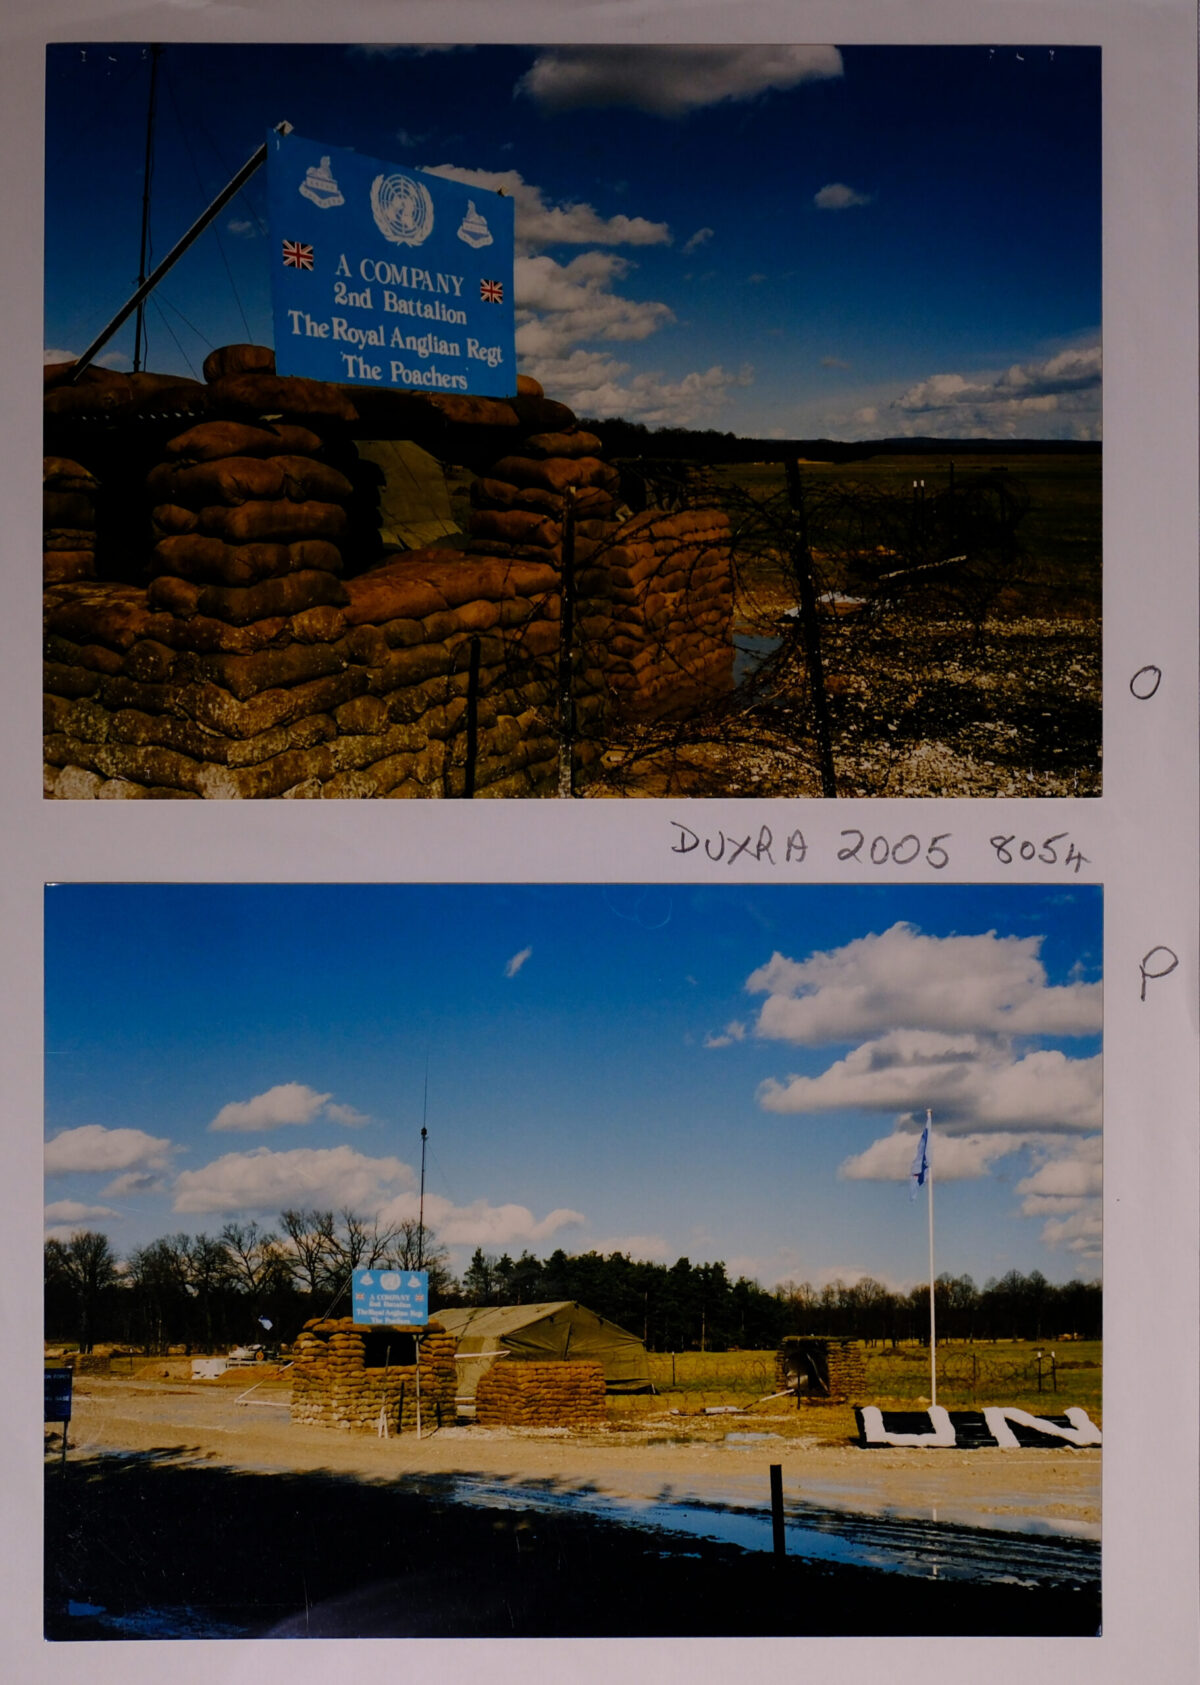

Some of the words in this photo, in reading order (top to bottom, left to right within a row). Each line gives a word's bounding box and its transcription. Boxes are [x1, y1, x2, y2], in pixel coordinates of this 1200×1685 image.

[335, 254, 352, 278] A
[360, 258, 465, 297] COMPANY
[334, 282, 373, 309] 2nd
[383, 290, 468, 325] Battalion
[287, 309, 330, 338] The
[331, 316, 385, 350] Royal
[390, 326, 461, 358] Anglian
[466, 338, 504, 368] Regt
[670, 820, 809, 866] DUXRA
[837, 829, 952, 869] 2005
[990, 831, 1092, 874] 8054
[1139, 945, 1179, 1002] P
[861, 1405, 1102, 1448] UN
